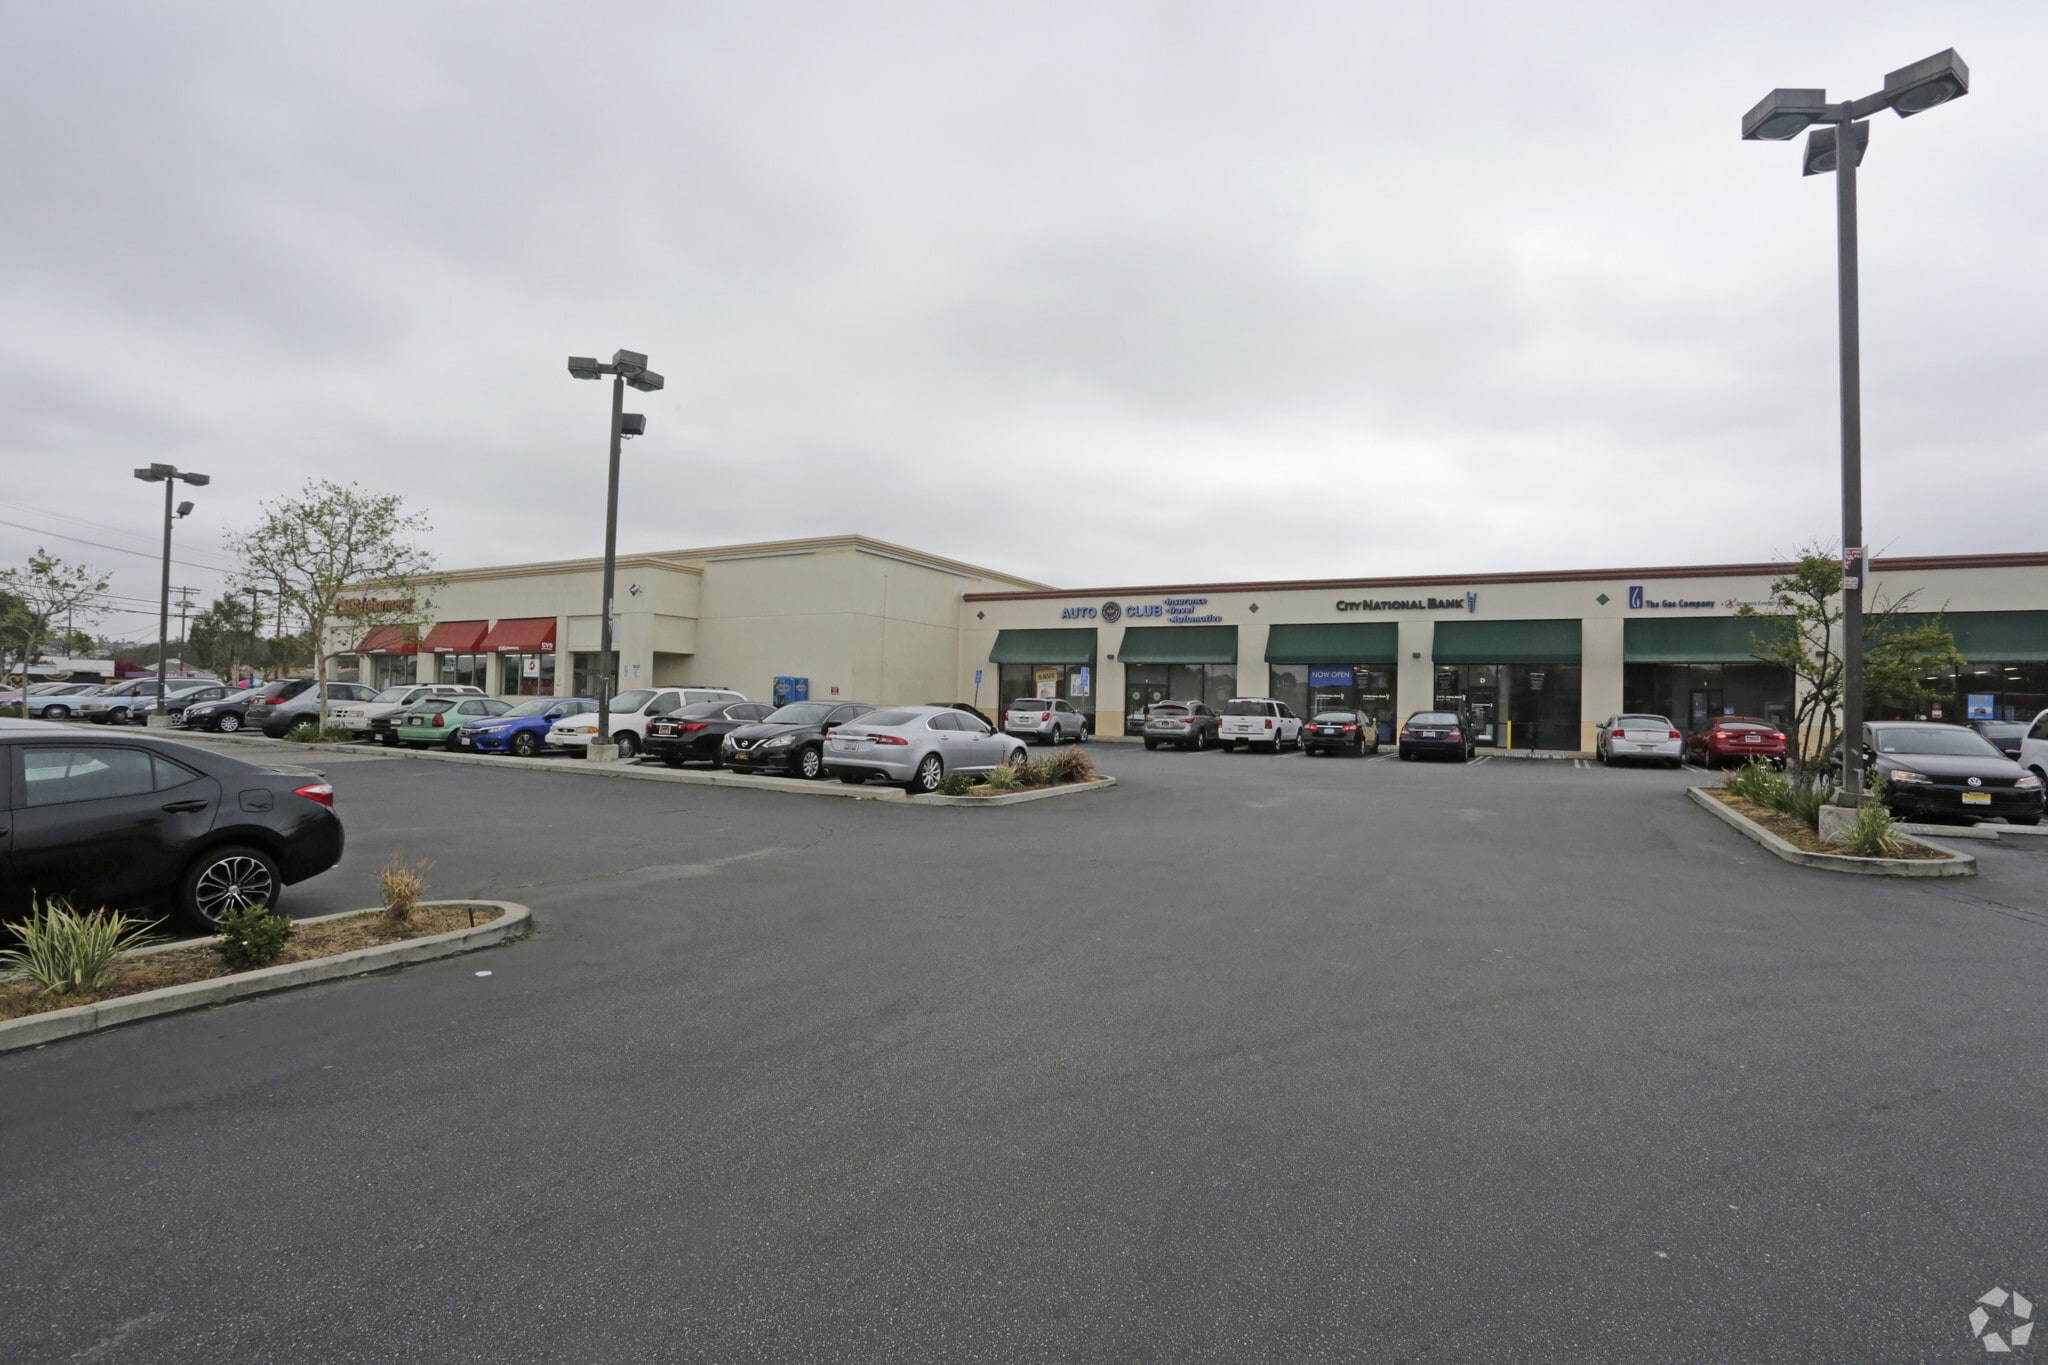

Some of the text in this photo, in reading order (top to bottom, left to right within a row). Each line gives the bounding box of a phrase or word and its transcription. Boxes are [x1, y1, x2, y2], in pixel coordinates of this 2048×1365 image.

[1646, 599, 1716, 609] The Gas Company
[1061, 605, 1163, 619] AUTO CLUB
[1038, 672, 1055, 680] SAVE
